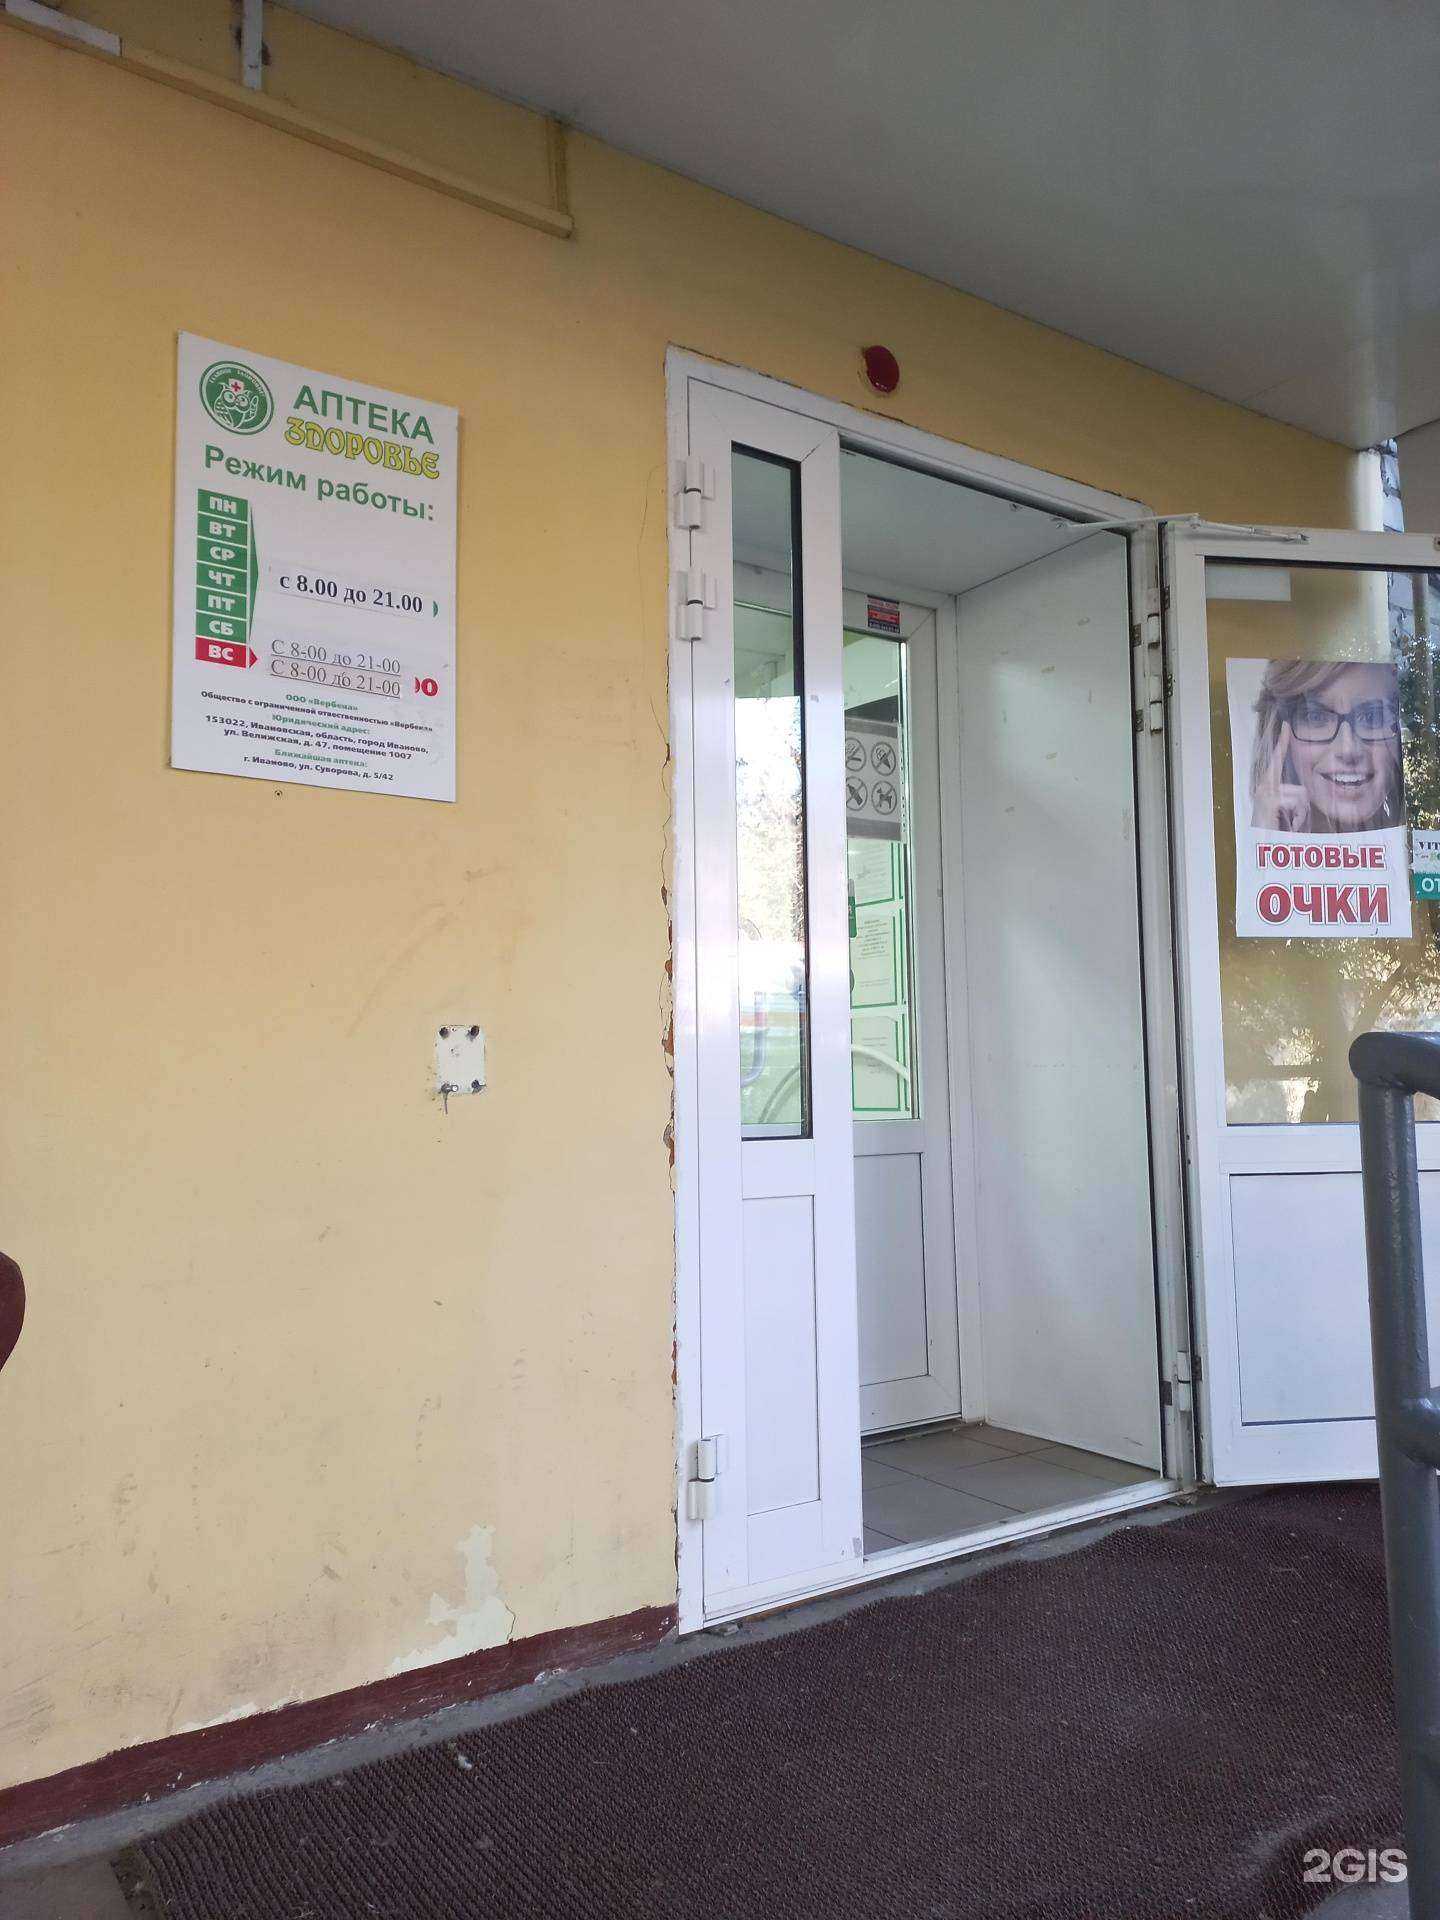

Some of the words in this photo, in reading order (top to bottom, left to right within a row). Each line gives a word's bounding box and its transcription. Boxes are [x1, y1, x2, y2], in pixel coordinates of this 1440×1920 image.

[293, 385, 435, 444] АПТЕКА
[284, 416, 440, 479] ЗДОРОВЬЕ
[204, 444, 306, 491] Режим
[317, 478, 434, 521] работы:
[209, 496, 238, 514] ПН
[209, 521, 236, 538] ВТ
[209, 546, 236, 561] СР
[208, 570, 236, 587] ЧТ
[207, 594, 235, 611] ПТ
[279, 576, 290, 588] с
[296, 574, 338, 597] 8.00
[343, 587, 366, 604] до
[373, 588, 422, 613] 21.00
[208, 620, 234, 635] СБ
[208, 644, 234, 661] ВС
[271, 639, 285, 654] С
[290, 642, 327, 662] 8-00
[332, 654, 351, 666] до
[356, 654, 400, 673] 21-00
[271, 659, 284, 675] С
[290, 662, 326, 682] 8-00
[331, 672, 351, 687] до
[356, 675, 400, 696] 21-00
[201, 691, 246, 704] Общество
[254, 700, 316, 715] ограниченной
[286, 694, 306, 703] ООО
[205, 715, 248, 728] 153022,
[316, 732, 356, 744] область,
[357, 739, 385, 749] город
[387, 741, 429, 754] Иваново,
[272, 714, 339, 730] Юридический
[341, 724, 370, 735] адрес:
[224, 729, 239, 737] ул.
[333, 744, 387, 757] помещение
[389, 751, 412, 760] 1007
[275, 749, 332, 762] Ближайшая
[252, 756, 297, 769] Иваново,
[298, 762, 313, 771] ул.
[374, 772, 394, 780] 5/42
[1257, 843, 1387, 870] ГОТОВЫЕ
[1257, 883, 1391, 925] ОЧКИ
